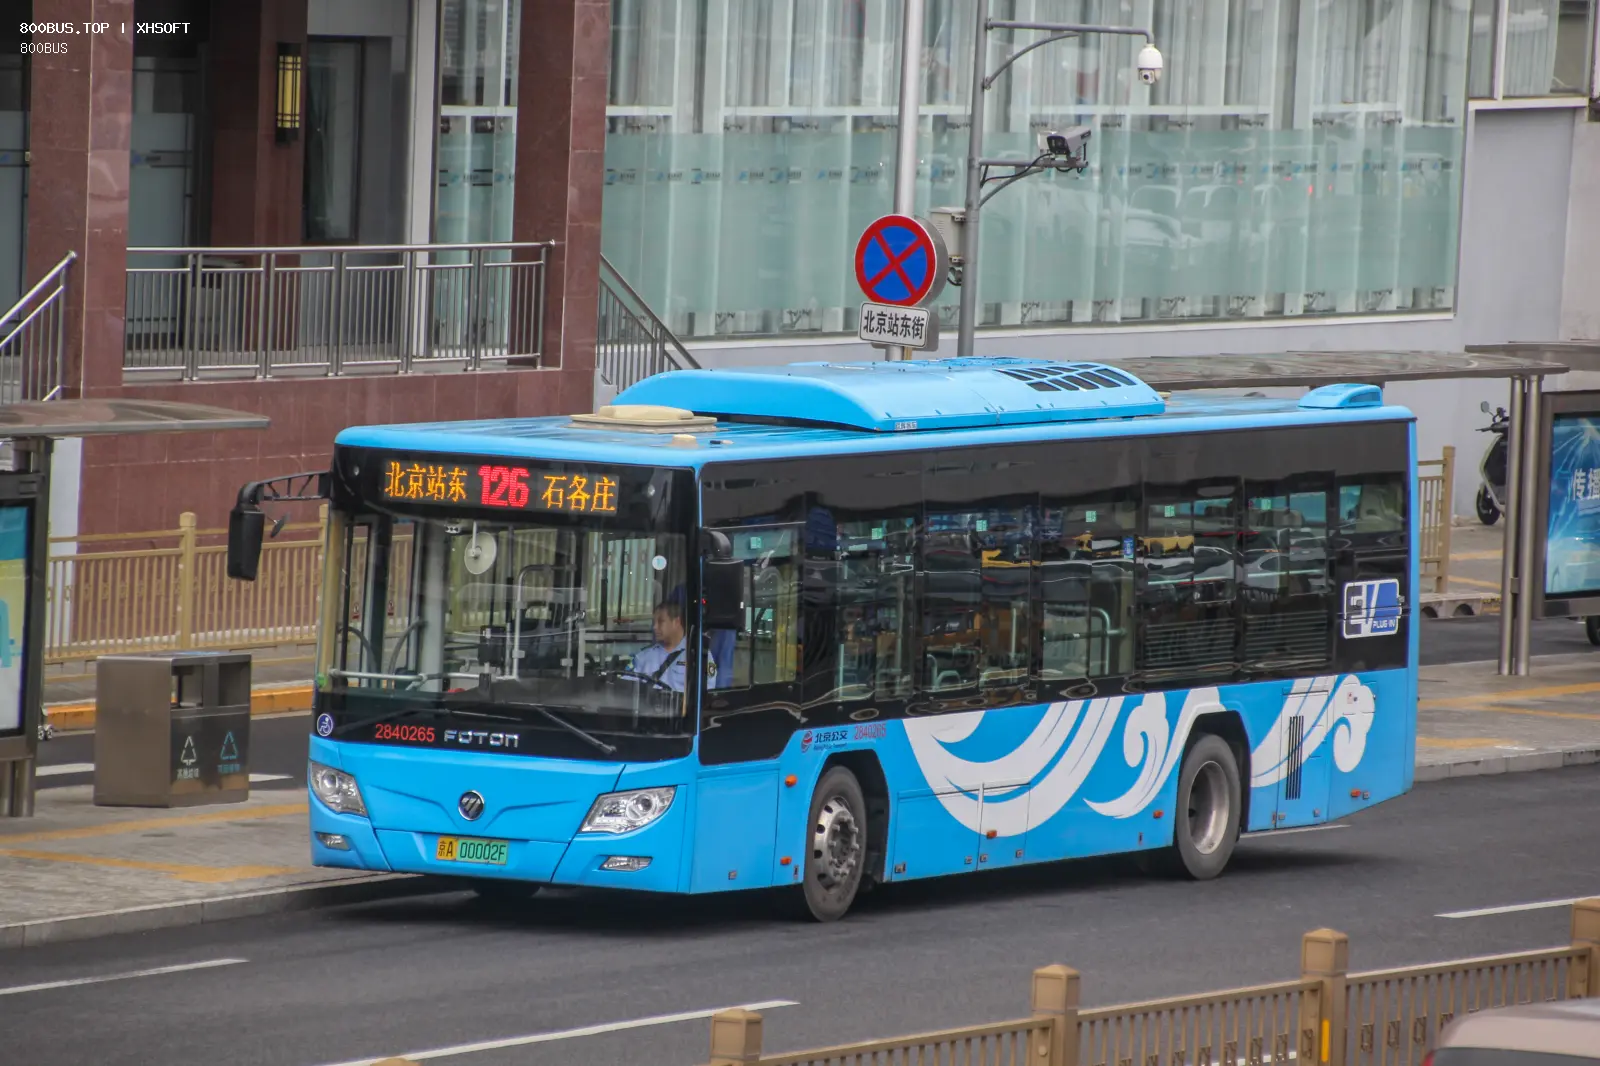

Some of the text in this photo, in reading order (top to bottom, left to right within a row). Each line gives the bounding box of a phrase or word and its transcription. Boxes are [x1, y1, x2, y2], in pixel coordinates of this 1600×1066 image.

[863, 310, 925, 340] 北京站东街
[384, 461, 617, 512] 北京站东 126 石各庄
[375, 723, 520, 748] 2840265 FOTON
[815, 724, 886, 743] 北京公交 2840265
